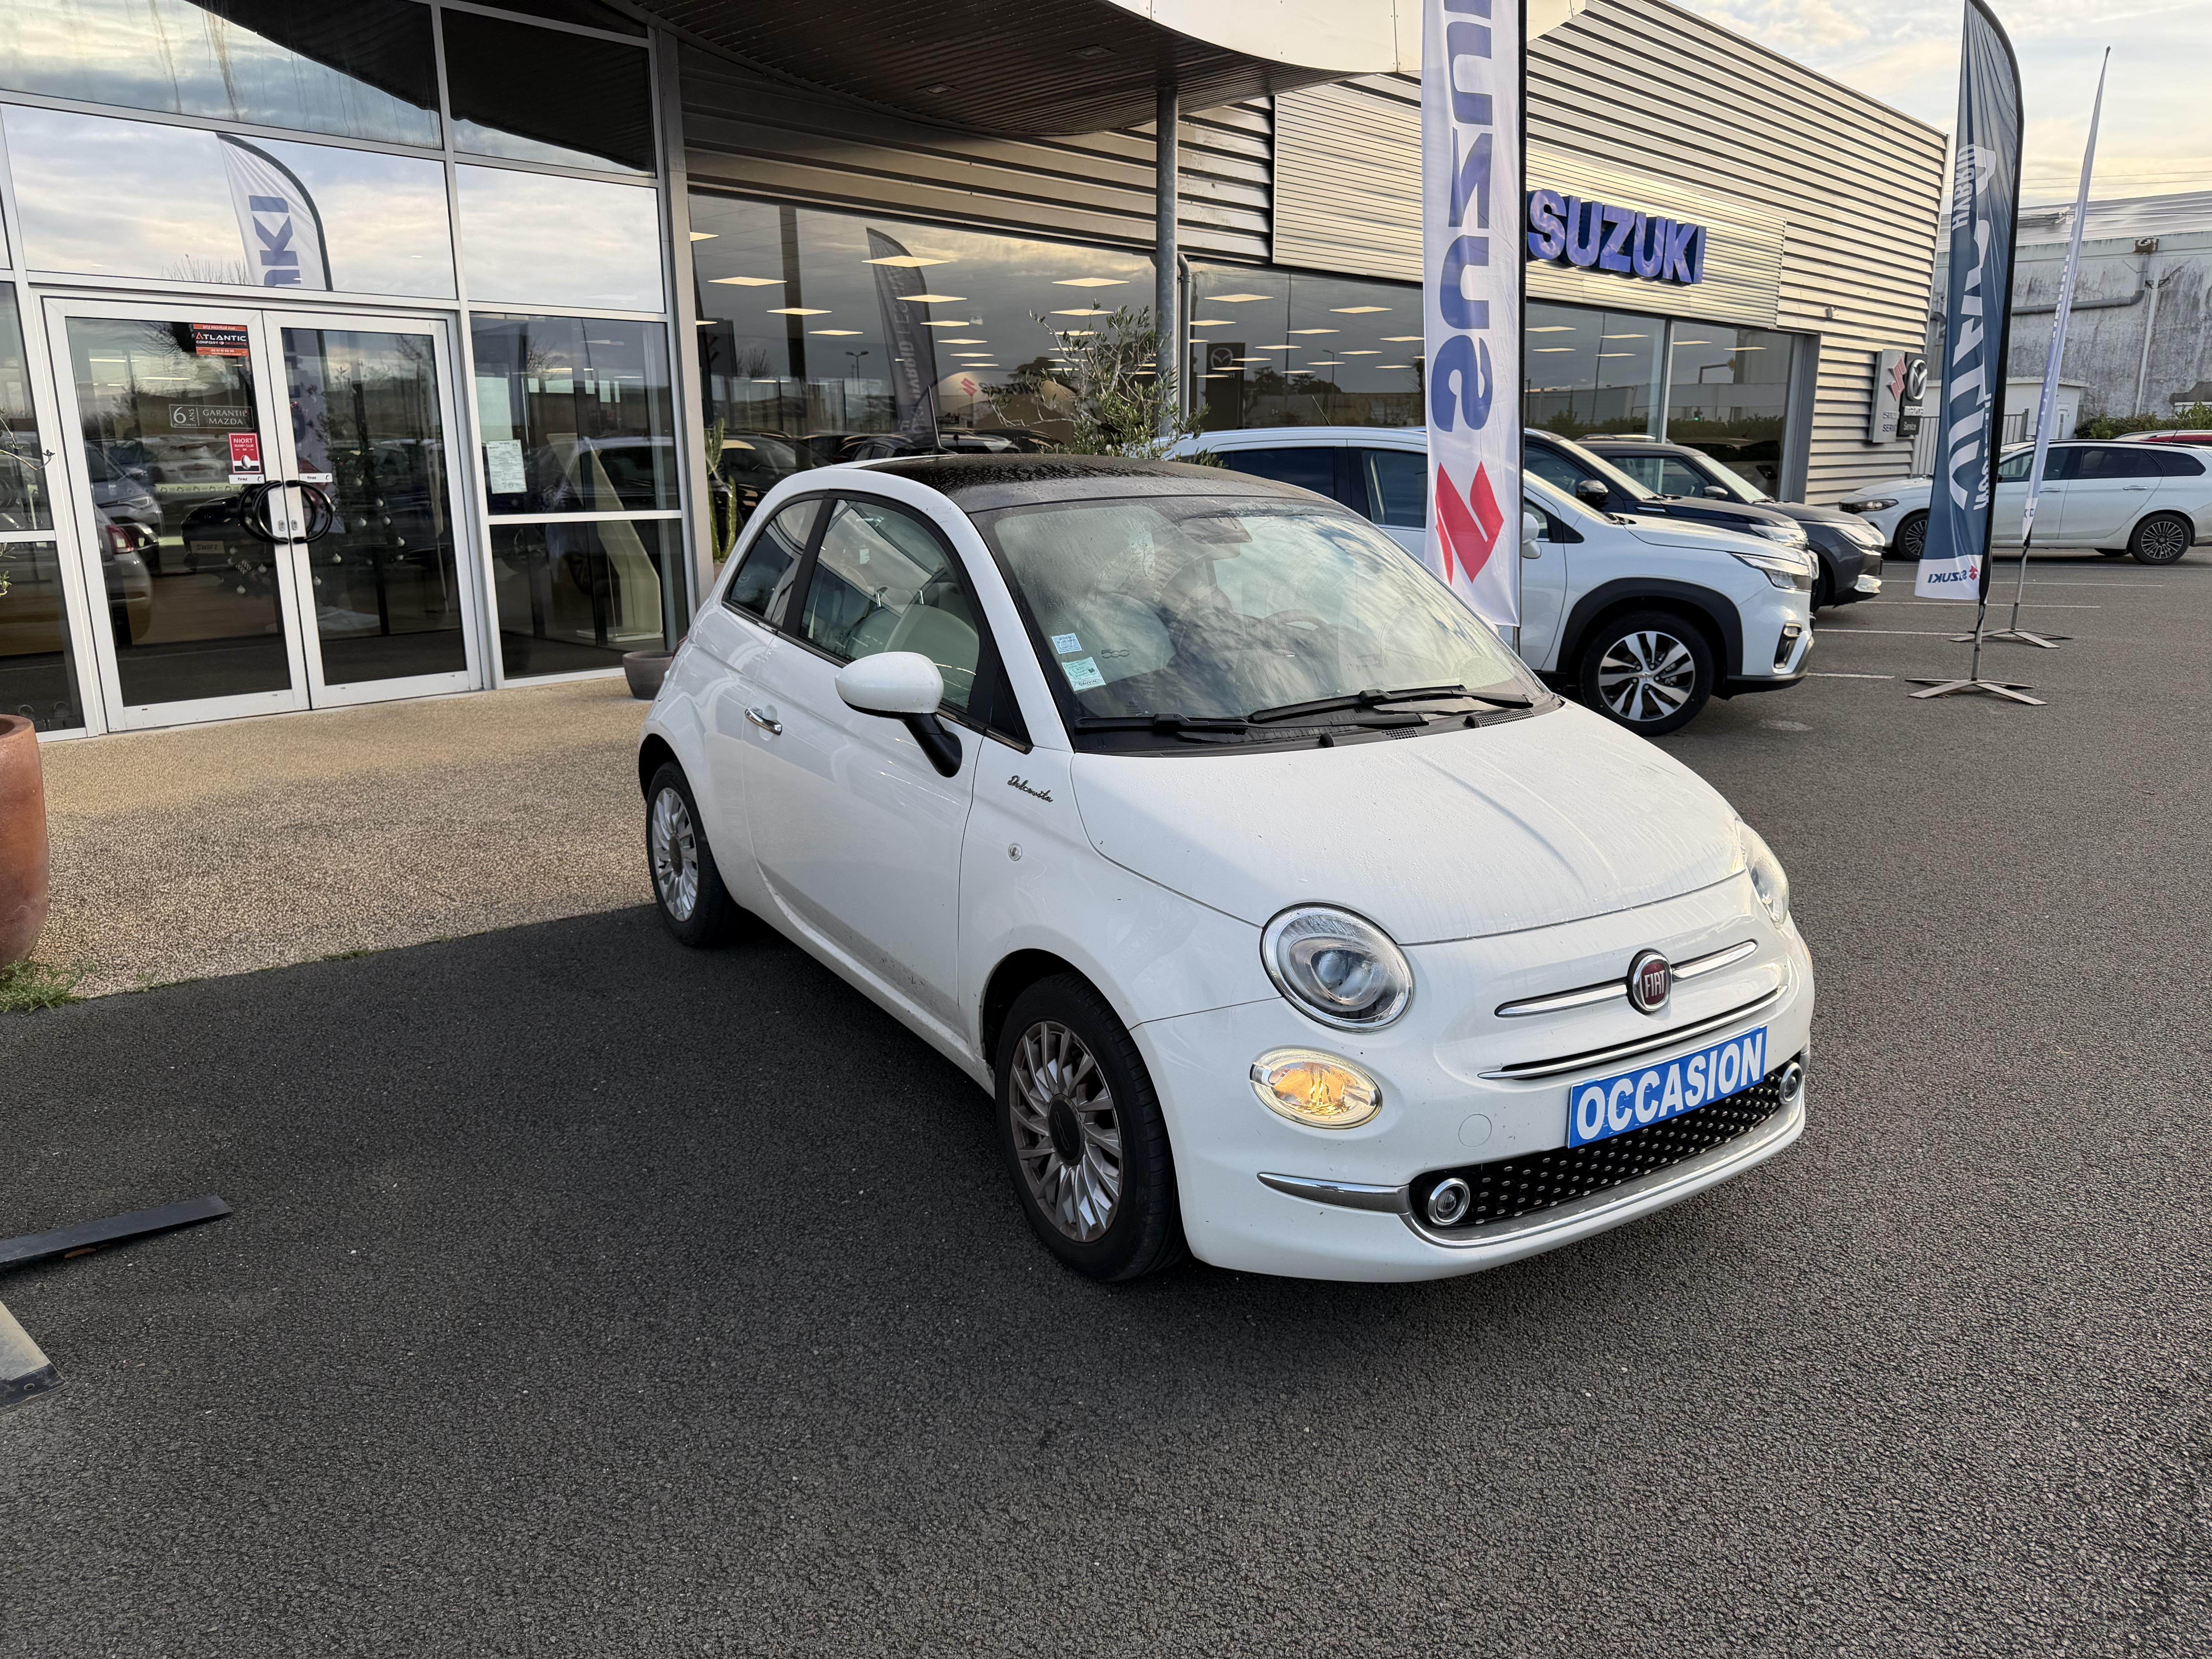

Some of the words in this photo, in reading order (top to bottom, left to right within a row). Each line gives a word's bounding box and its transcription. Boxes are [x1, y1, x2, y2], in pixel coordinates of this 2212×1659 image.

[1527, 189, 1706, 284] SUZUKI
[196, 331, 247, 342] ATLANTIC
[173, 407, 187, 424] 6
[202, 409, 248, 417] GARANTIE
[1007, 775, 1053, 802] Dolcevita
[1644, 969, 1665, 998] FIAT
[1577, 1032, 1763, 1140] OCCASION
